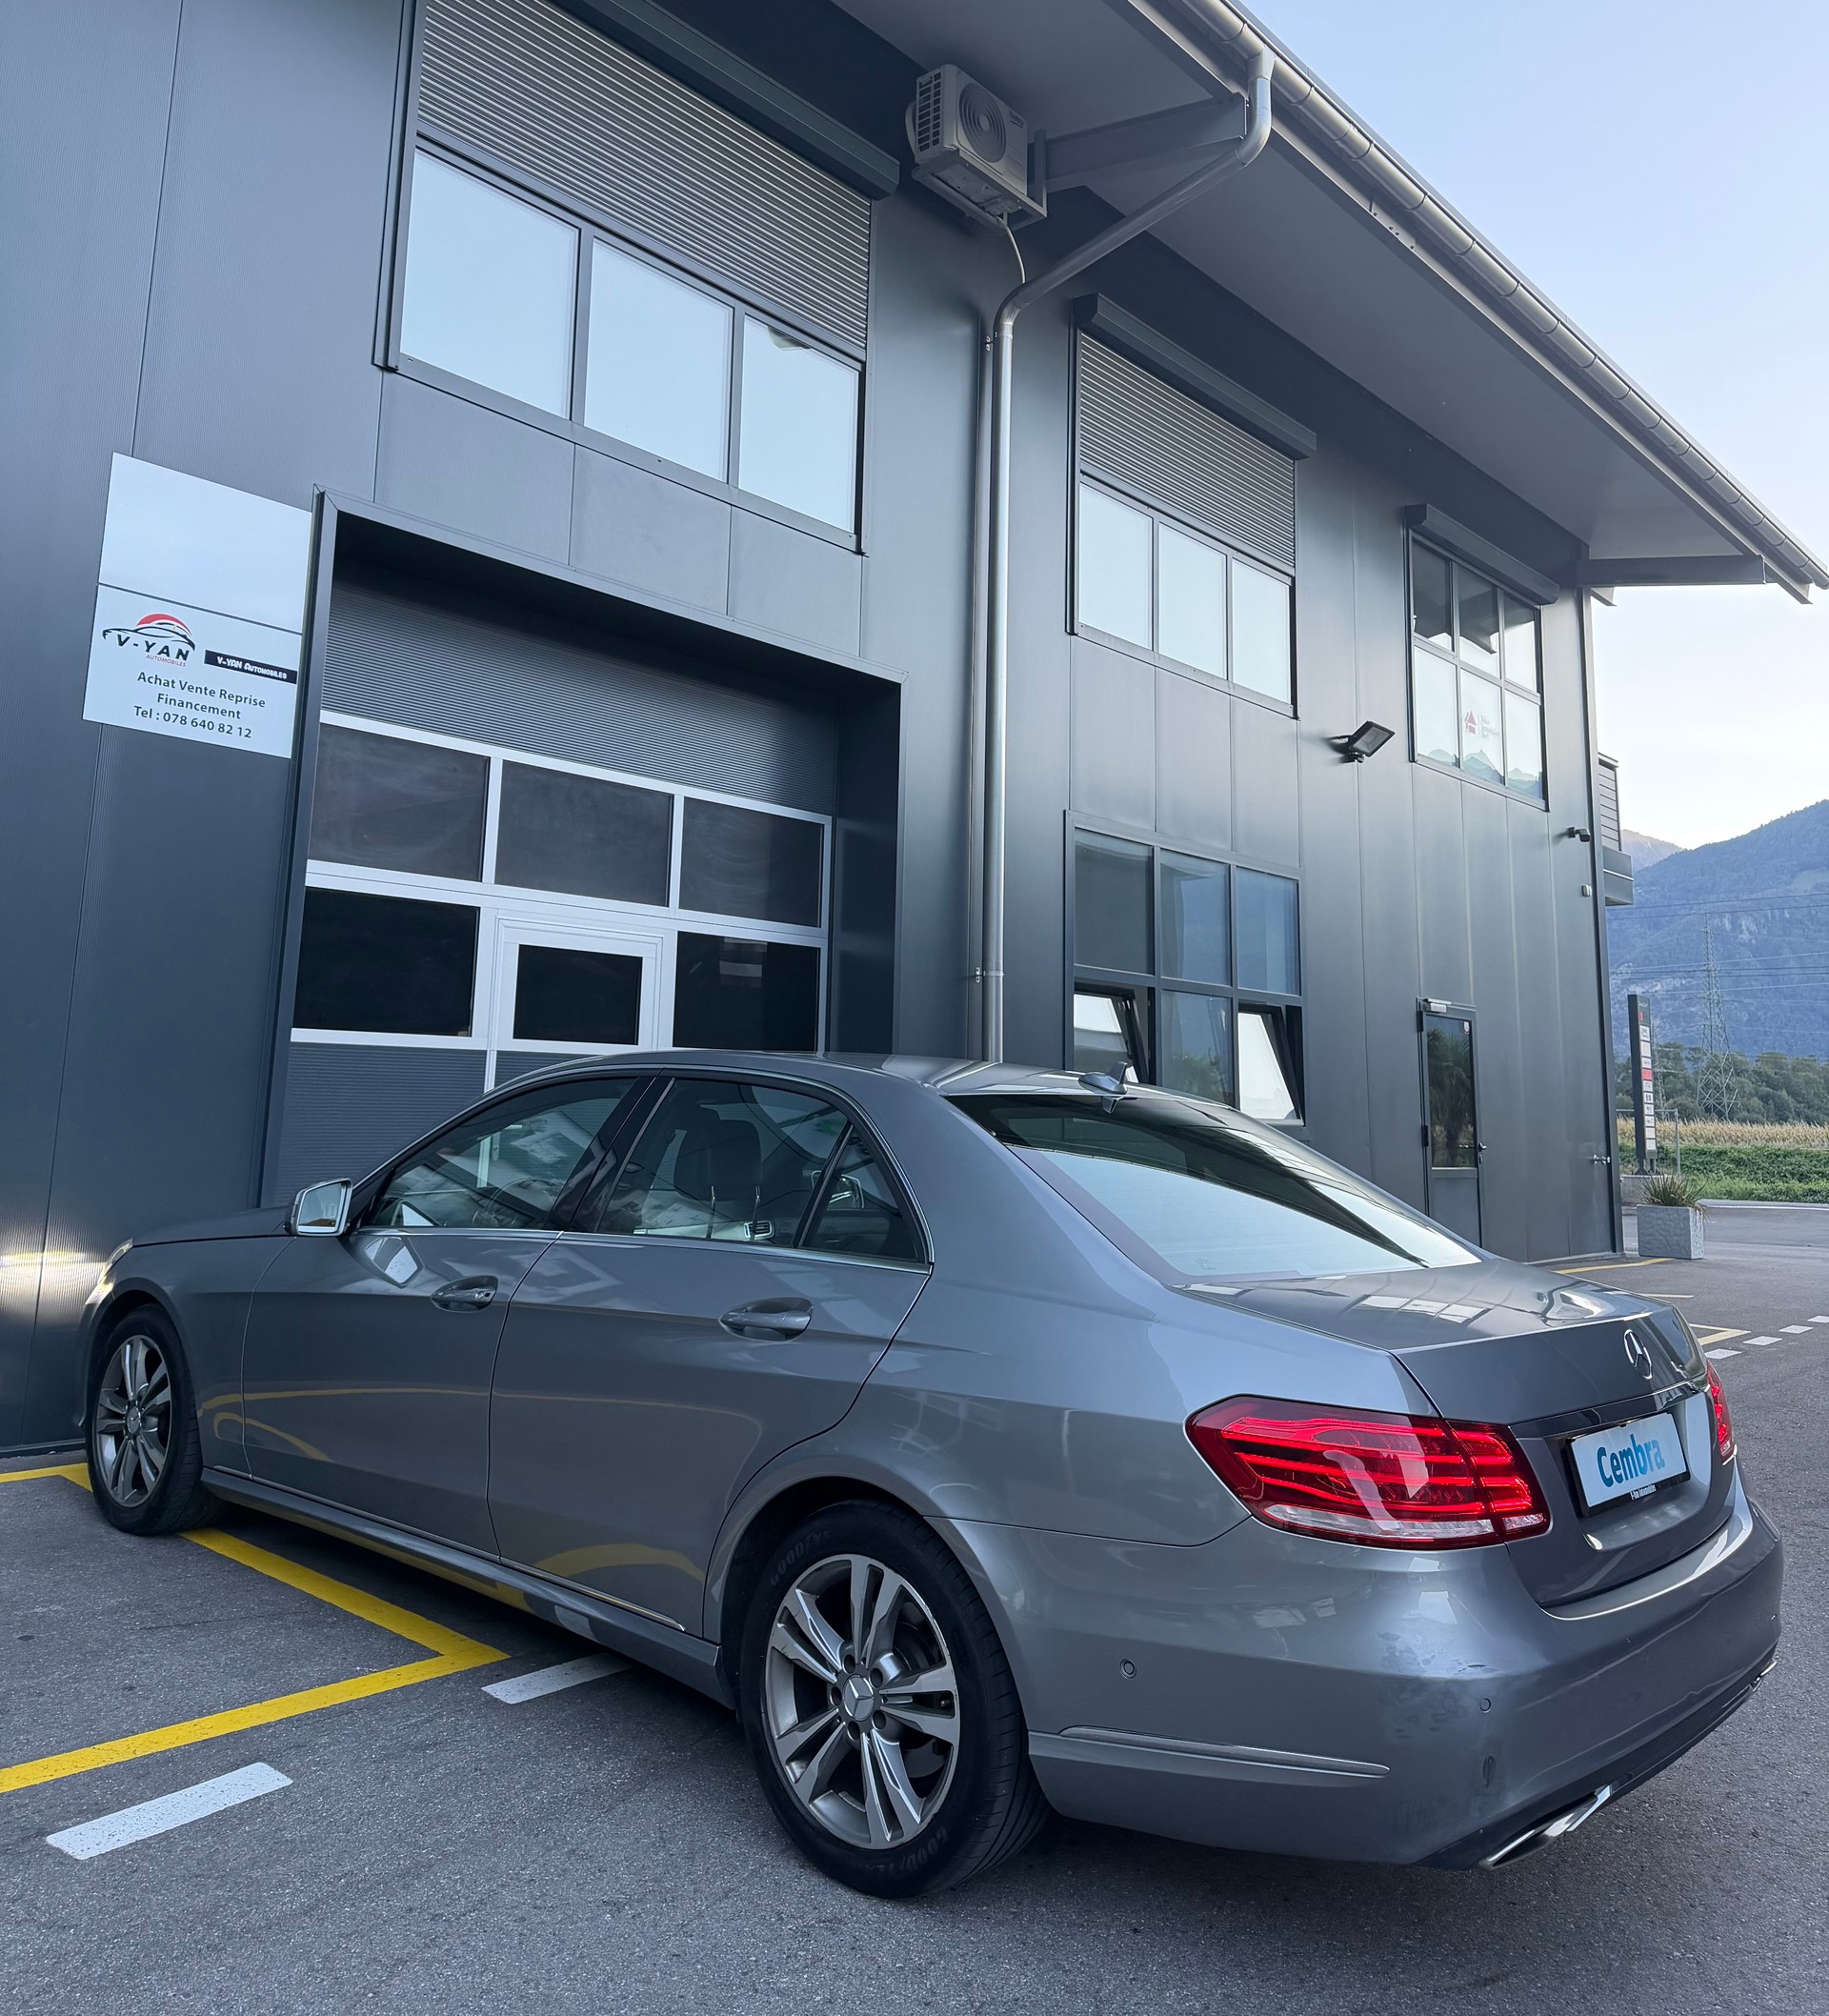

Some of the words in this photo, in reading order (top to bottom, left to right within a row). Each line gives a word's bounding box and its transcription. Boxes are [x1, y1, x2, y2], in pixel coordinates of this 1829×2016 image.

[117, 634, 190, 661] V-YAN
[146, 654, 187, 668] AUTOMOBILES
[216, 655, 242, 669] V-YAN
[137, 672, 176, 689] Achat
[179, 679, 216, 696] Vente
[219, 689, 266, 708] Reprise
[157, 693, 241, 719] Financement
[133, 705, 152, 718] Tel
[163, 712, 188, 725] 078
[191, 717, 214, 731] 640
[217, 722, 233, 735] 82
[237, 727, 251, 738] 12
[1597, 1433, 1665, 1488] Cembra
